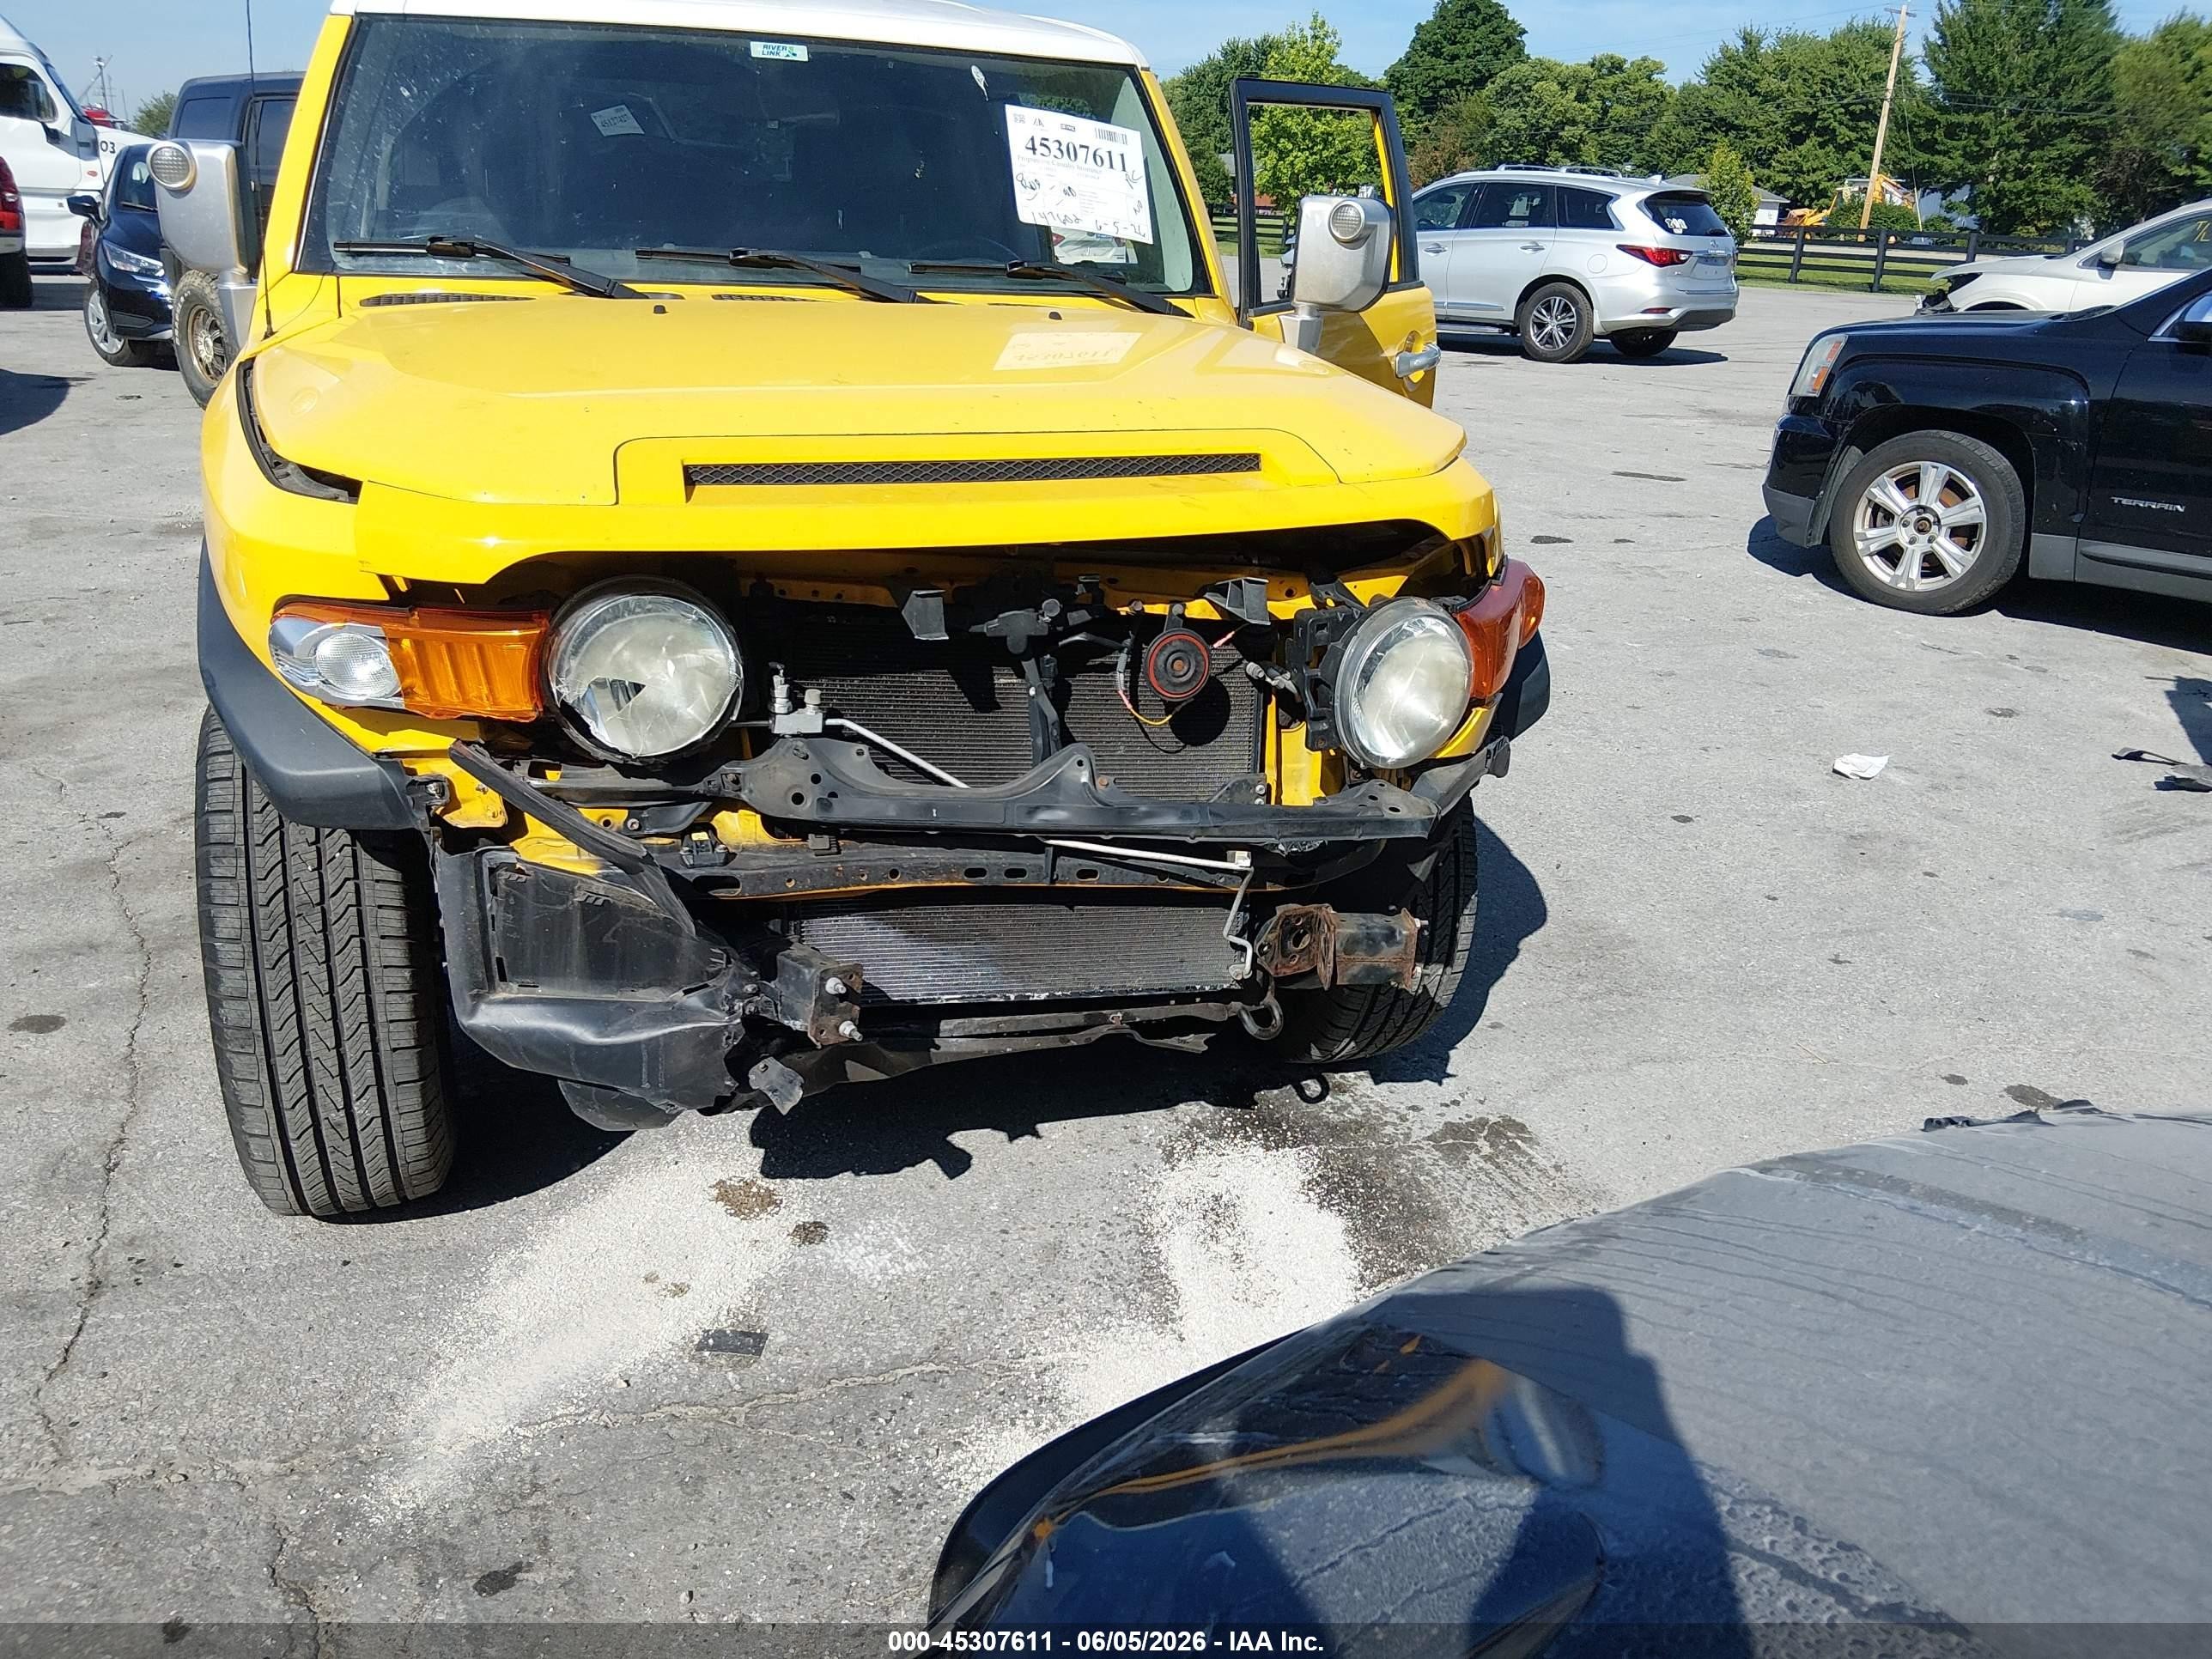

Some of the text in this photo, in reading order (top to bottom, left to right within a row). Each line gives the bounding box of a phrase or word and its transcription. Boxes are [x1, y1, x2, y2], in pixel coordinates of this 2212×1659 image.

[100, 140, 116, 154] 03
[1024, 136, 1127, 172] 45307611
[2111, 496, 2185, 513] TERRAIN
